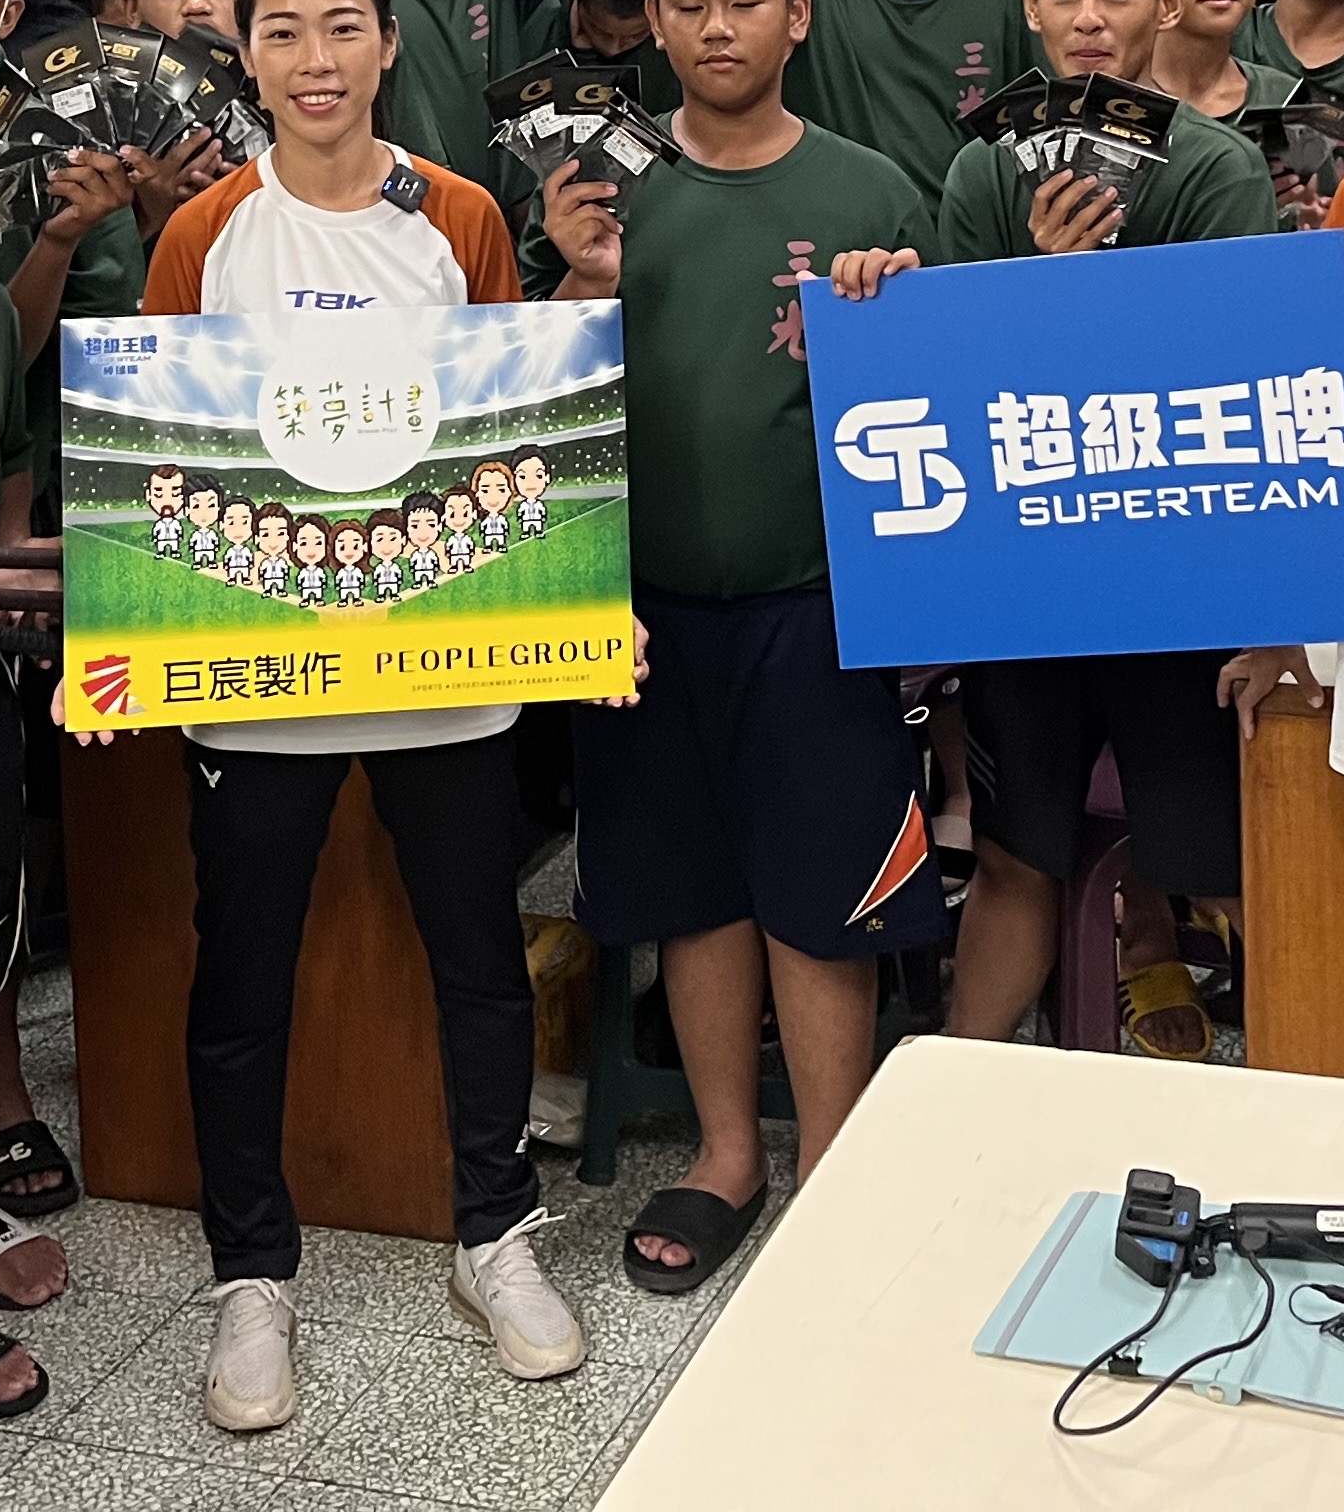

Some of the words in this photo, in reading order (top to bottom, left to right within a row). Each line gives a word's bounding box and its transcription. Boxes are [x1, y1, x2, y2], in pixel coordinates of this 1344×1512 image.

[285, 290, 379, 310] TBK
[84, 335, 158, 356] 超級王牌
[1018, 476, 1339, 527] SUPERTEAM
[376, 638, 623, 674] PEOPLEGROUP
[162, 651, 342, 705] 巨宸製作
